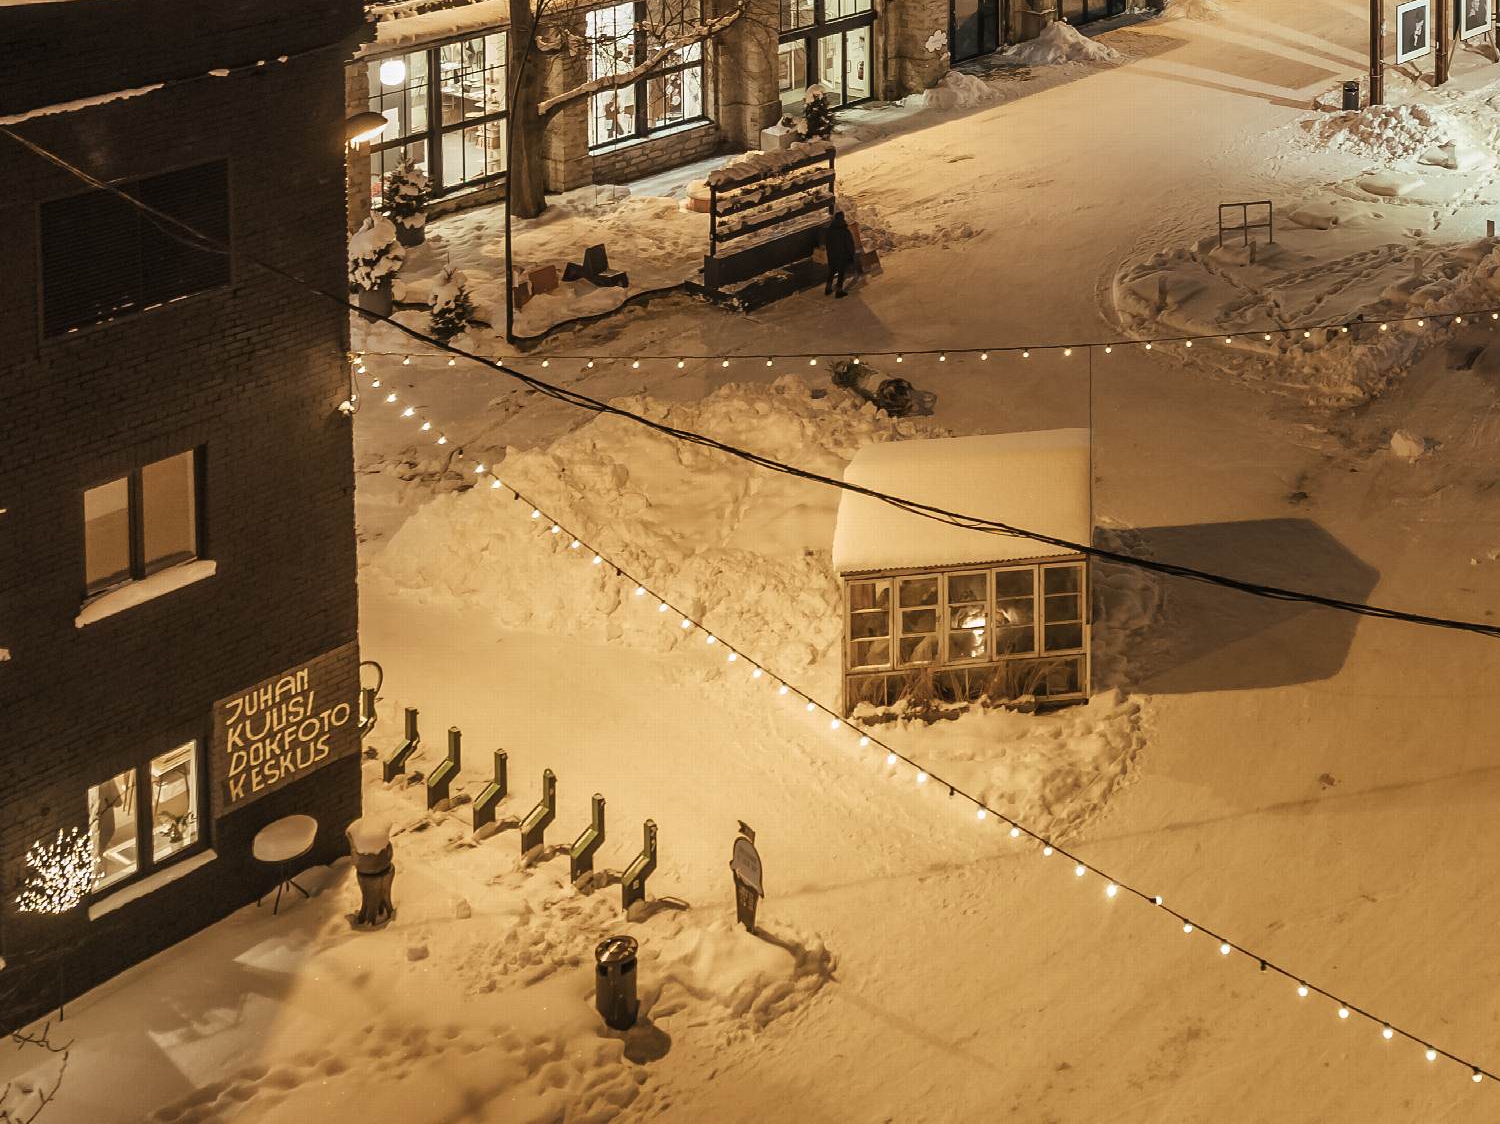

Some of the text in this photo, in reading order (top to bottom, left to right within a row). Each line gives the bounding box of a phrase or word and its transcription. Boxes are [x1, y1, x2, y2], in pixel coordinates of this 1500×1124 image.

[225, 667, 309, 726] JUHAN
[226, 690, 315, 753] KUUSI
[228, 702, 350, 778] DOKFOTO
[228, 733, 331, 803] KESKUS
